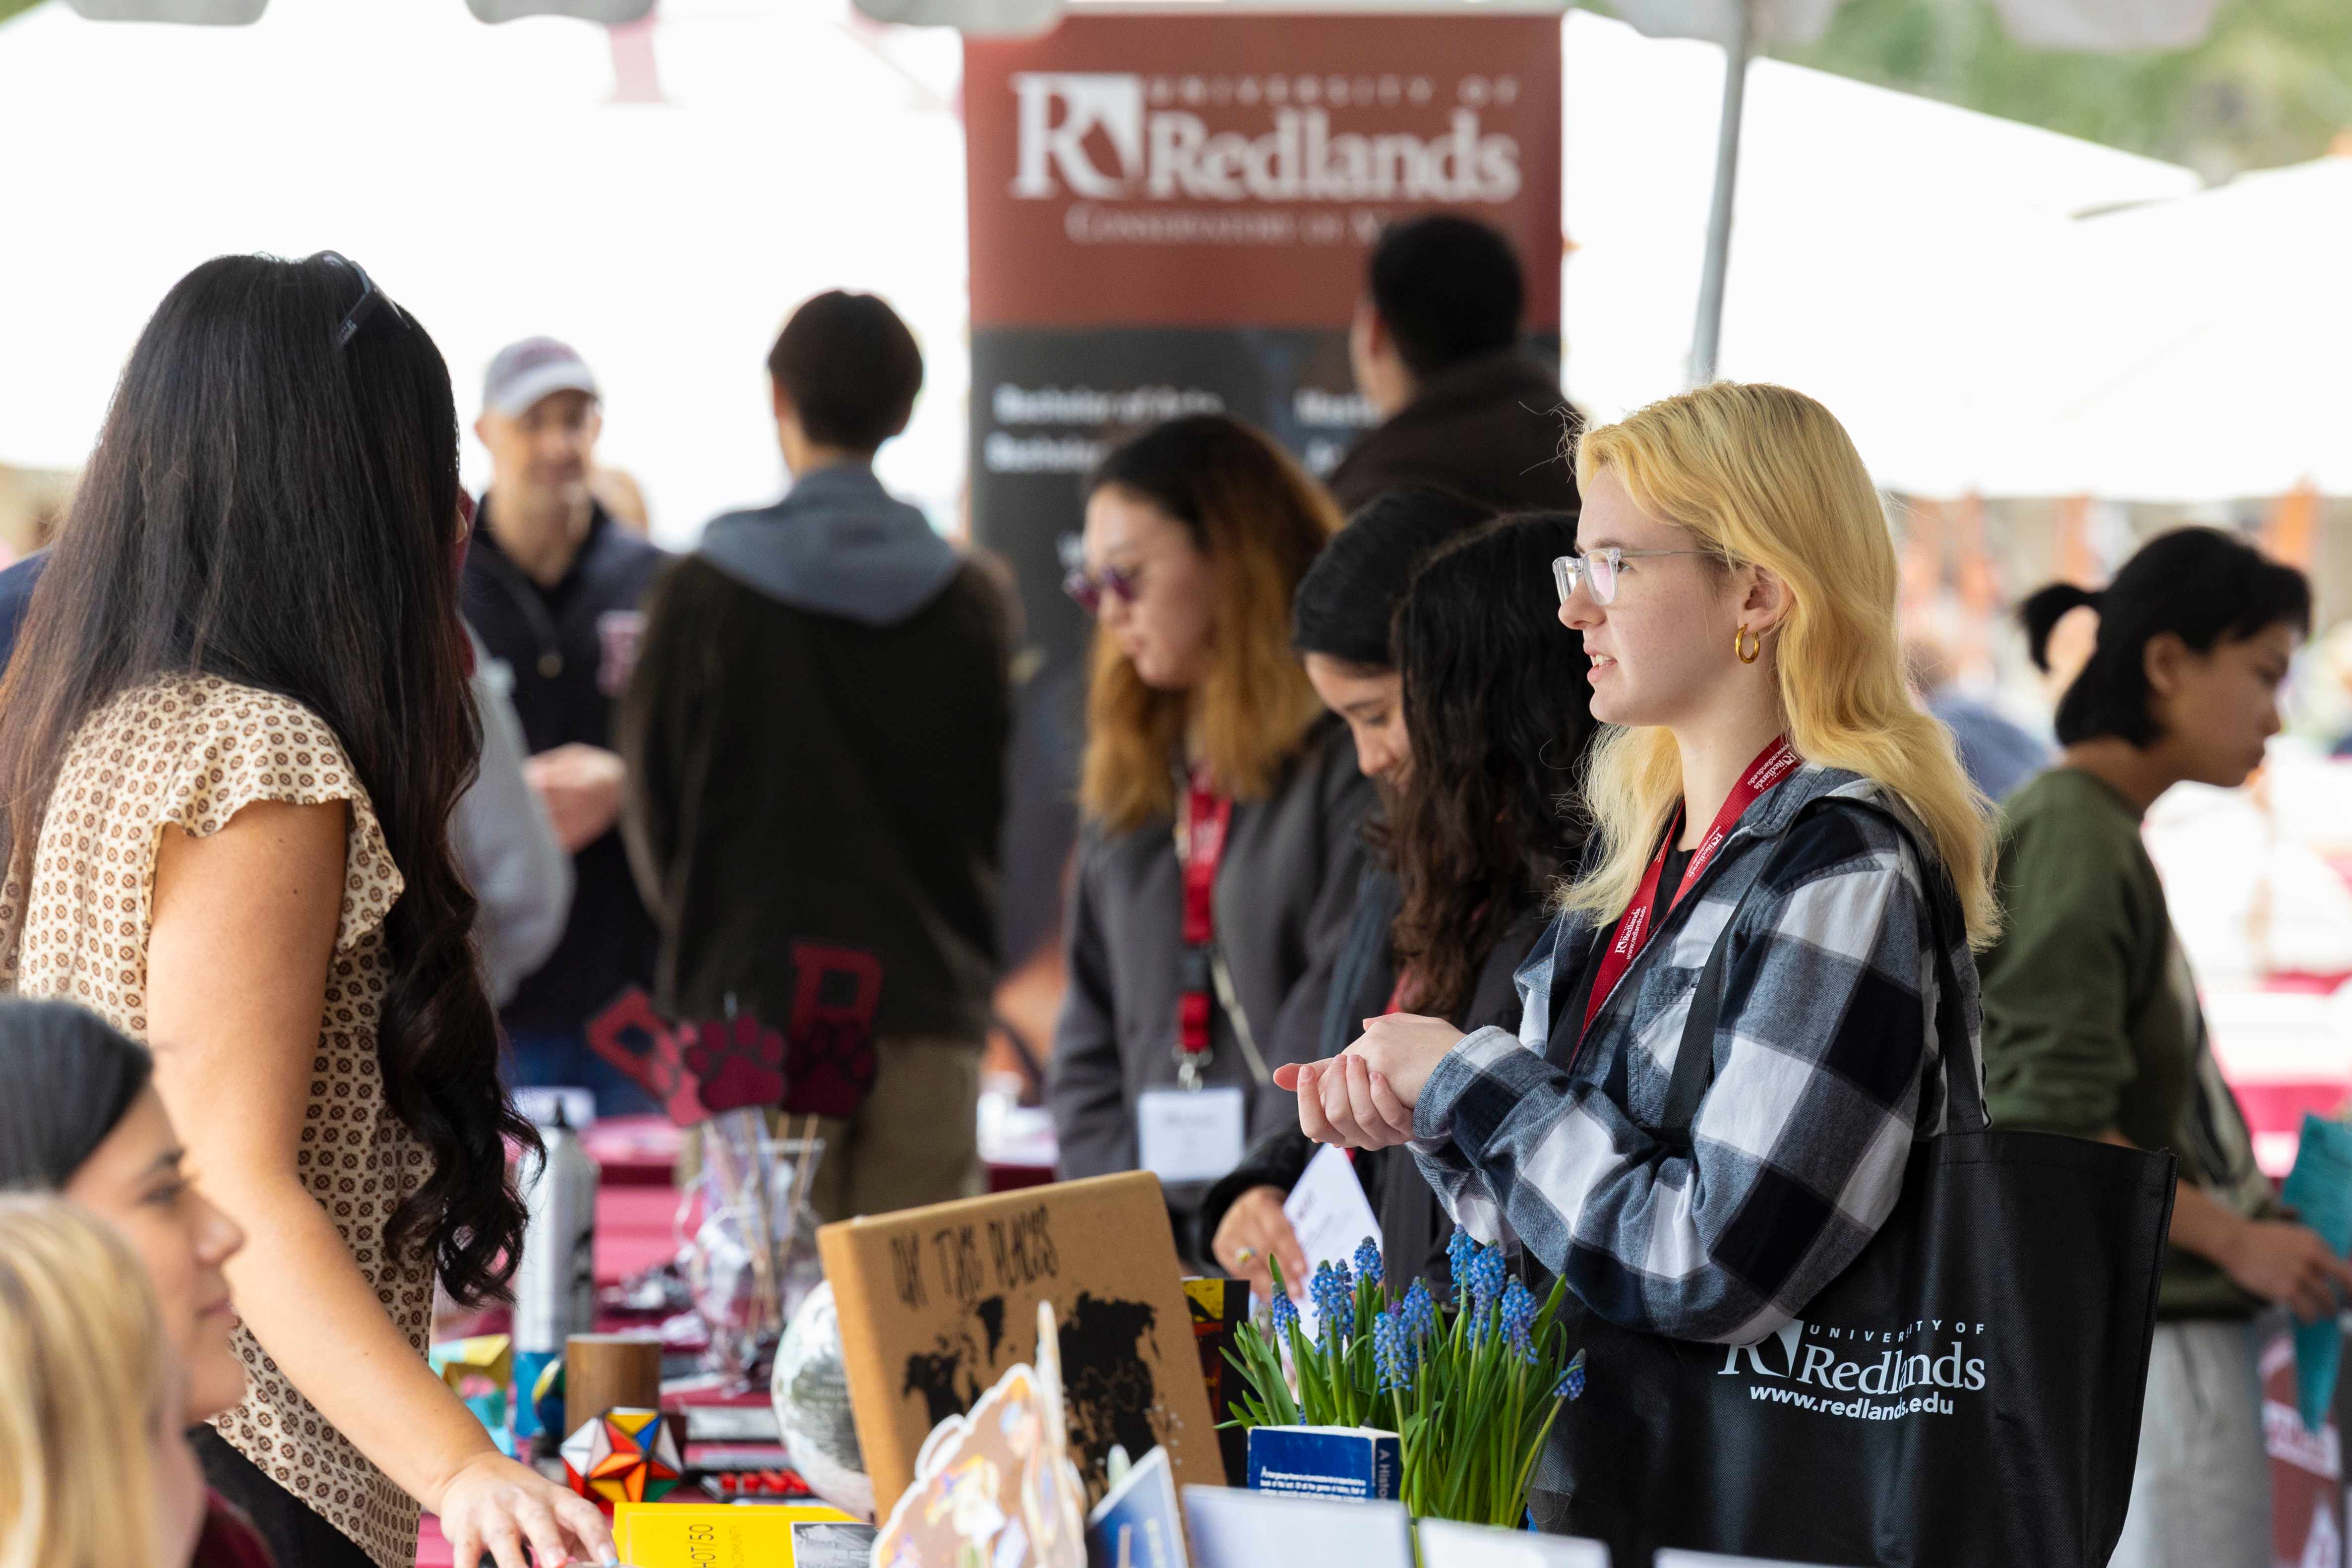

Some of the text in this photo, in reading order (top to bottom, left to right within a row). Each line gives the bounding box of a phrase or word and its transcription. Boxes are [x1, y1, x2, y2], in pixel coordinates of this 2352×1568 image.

[1150, 107, 1521, 199] Redlands
[1753, 759, 1786, 789] Redlands
[1622, 907, 1641, 942] Redlands
[1627, 905, 1647, 960] www.redlands.edu
[1810, 1320, 1985, 1343] UNIVERSITY OF
[1796, 1341, 1986, 1395] Redlands
[1749, 1387, 1954, 1421] www.redlands.edu
